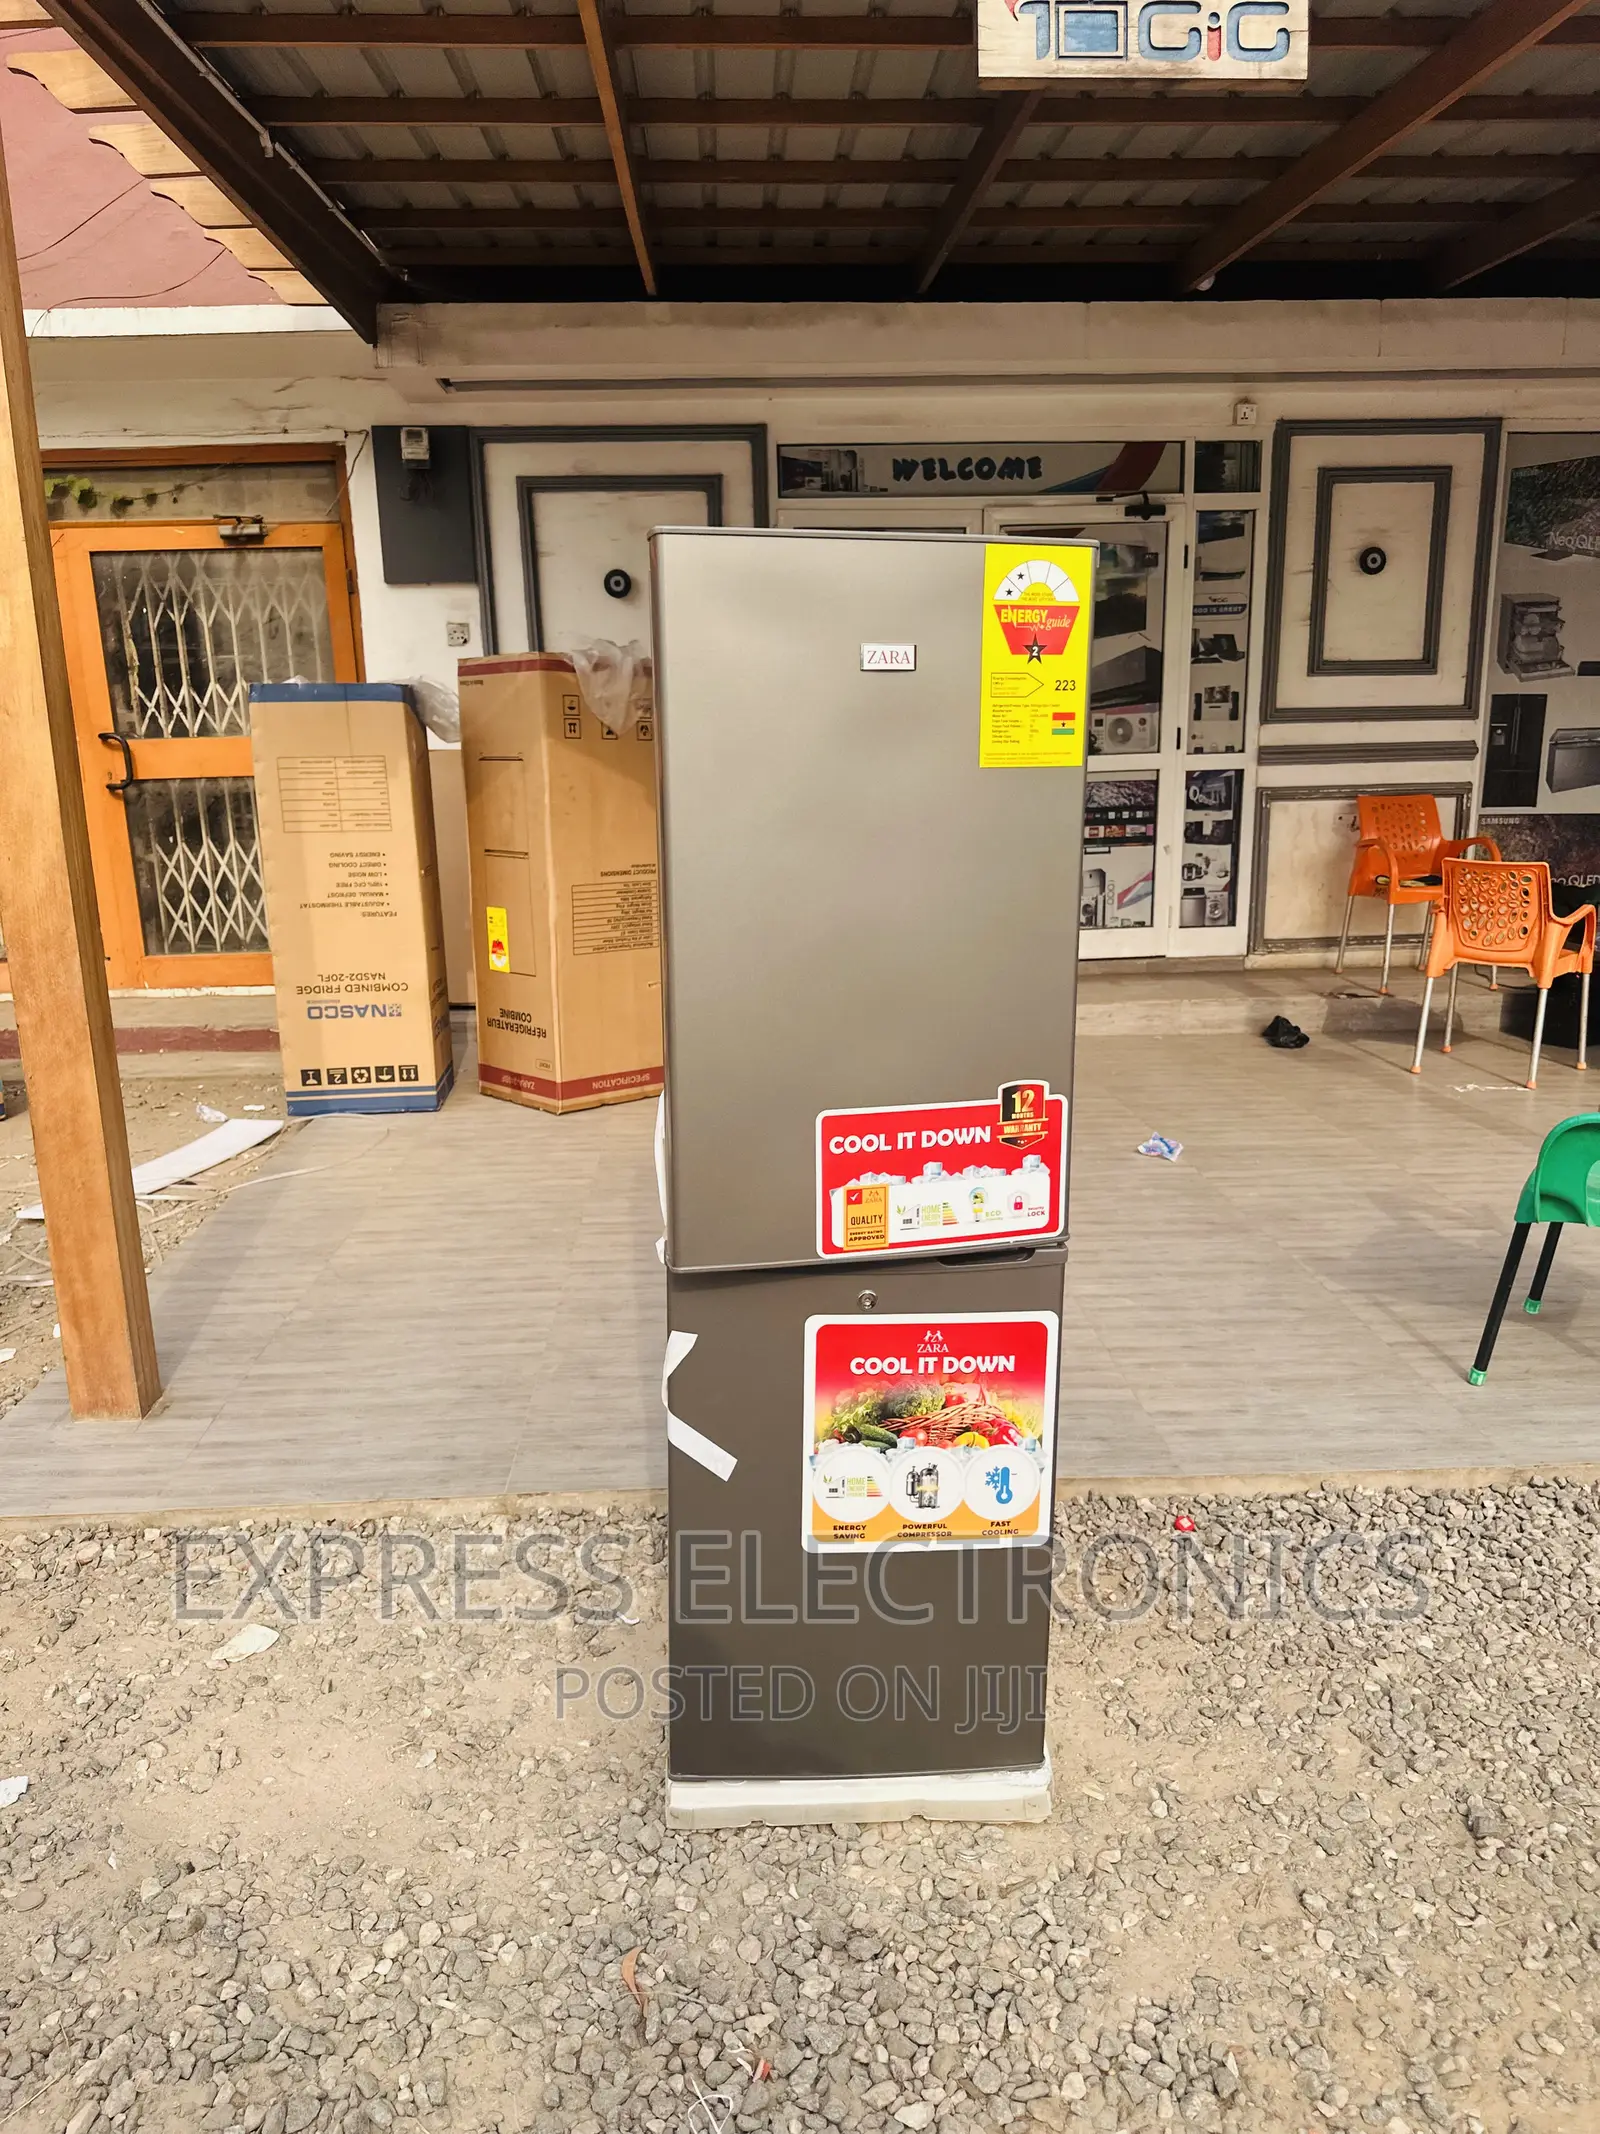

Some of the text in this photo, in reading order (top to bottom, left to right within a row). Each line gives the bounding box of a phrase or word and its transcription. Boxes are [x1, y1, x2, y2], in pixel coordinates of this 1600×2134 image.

[892, 456, 1043, 481] WELCOME
[1001, 606, 1071, 631] ENERGY guide
[867, 650, 911, 664] ZARA
[1032, 646, 1038, 656] 2
[1055, 680, 1076, 691] 223
[1480, 817, 1520, 825] SAMSUNG
[633, 868, 656, 876] PRODUCT
[318, 972, 386, 982] NASD2-20FL
[296, 982, 408, 995] COMBINED FRIDGE
[307, 1004, 387, 1020] NASCO
[499, 1008, 532, 1023] COMBINE
[487, 1017, 546, 1039] RÉFRIGÉRATEUR
[592, 1073, 650, 1090] SPECIFICATION
[1012, 1090, 1034, 1113] 12
[1004, 1123, 1042, 1134] WARRANTY
[829, 1126, 991, 1155] COOL IT DOWN
[922, 1204, 941, 1212] HOME
[851, 1214, 883, 1226] QUALITY
[917, 1343, 949, 1353] ZARA
[850, 1355, 1015, 1375] COOL IT DOWN
[833, 1524, 867, 1532] ENERGY
[990, 1520, 1011, 1528] FAST
[982, 1528, 1019, 1536] COOLING
